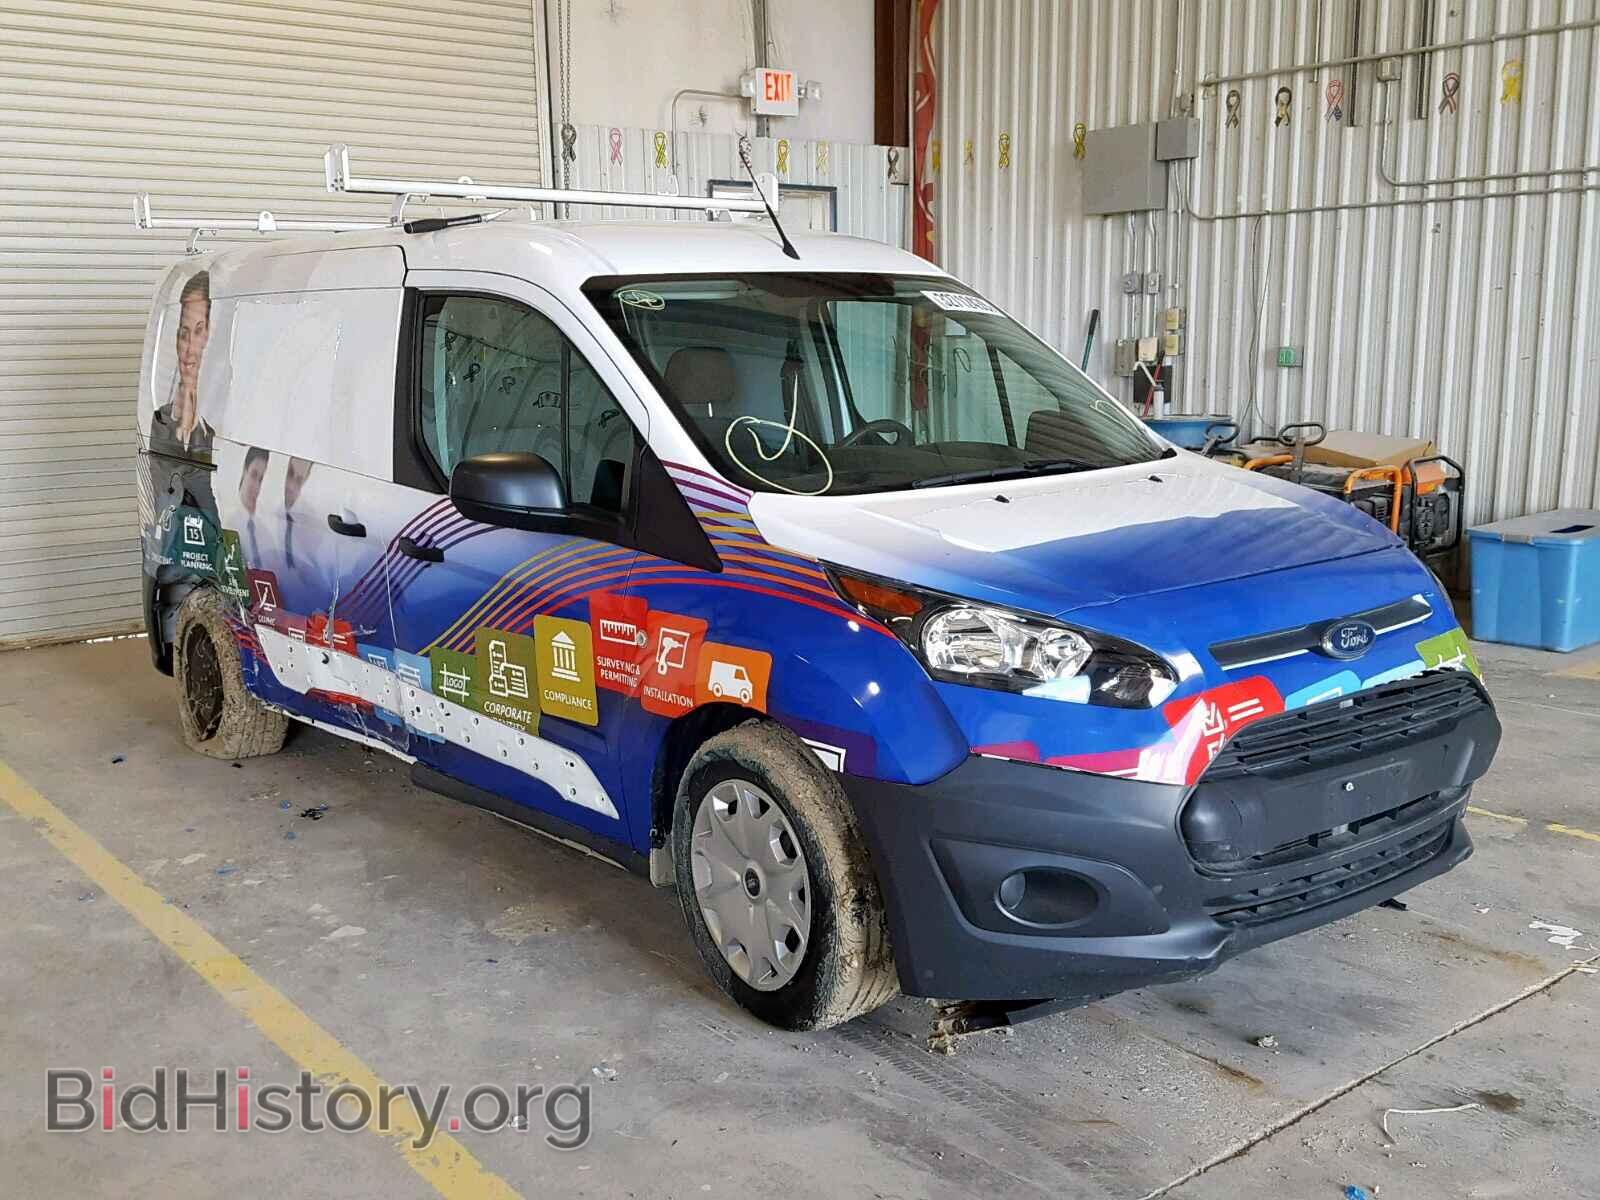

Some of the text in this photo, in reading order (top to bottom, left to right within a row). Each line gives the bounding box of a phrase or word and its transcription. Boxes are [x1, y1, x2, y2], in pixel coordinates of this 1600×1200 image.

[765, 72, 791, 101] EXIT
[188, 528, 199, 540] 15
[182, 551, 209, 562] PROJECT
[1341, 626, 1369, 648] Ford
[446, 677, 464, 689] LOGO
[543, 689, 593, 710] COMPLIANCE
[643, 685, 693, 708] INSTALLATION
[483, 701, 533, 723] CORPORATE
